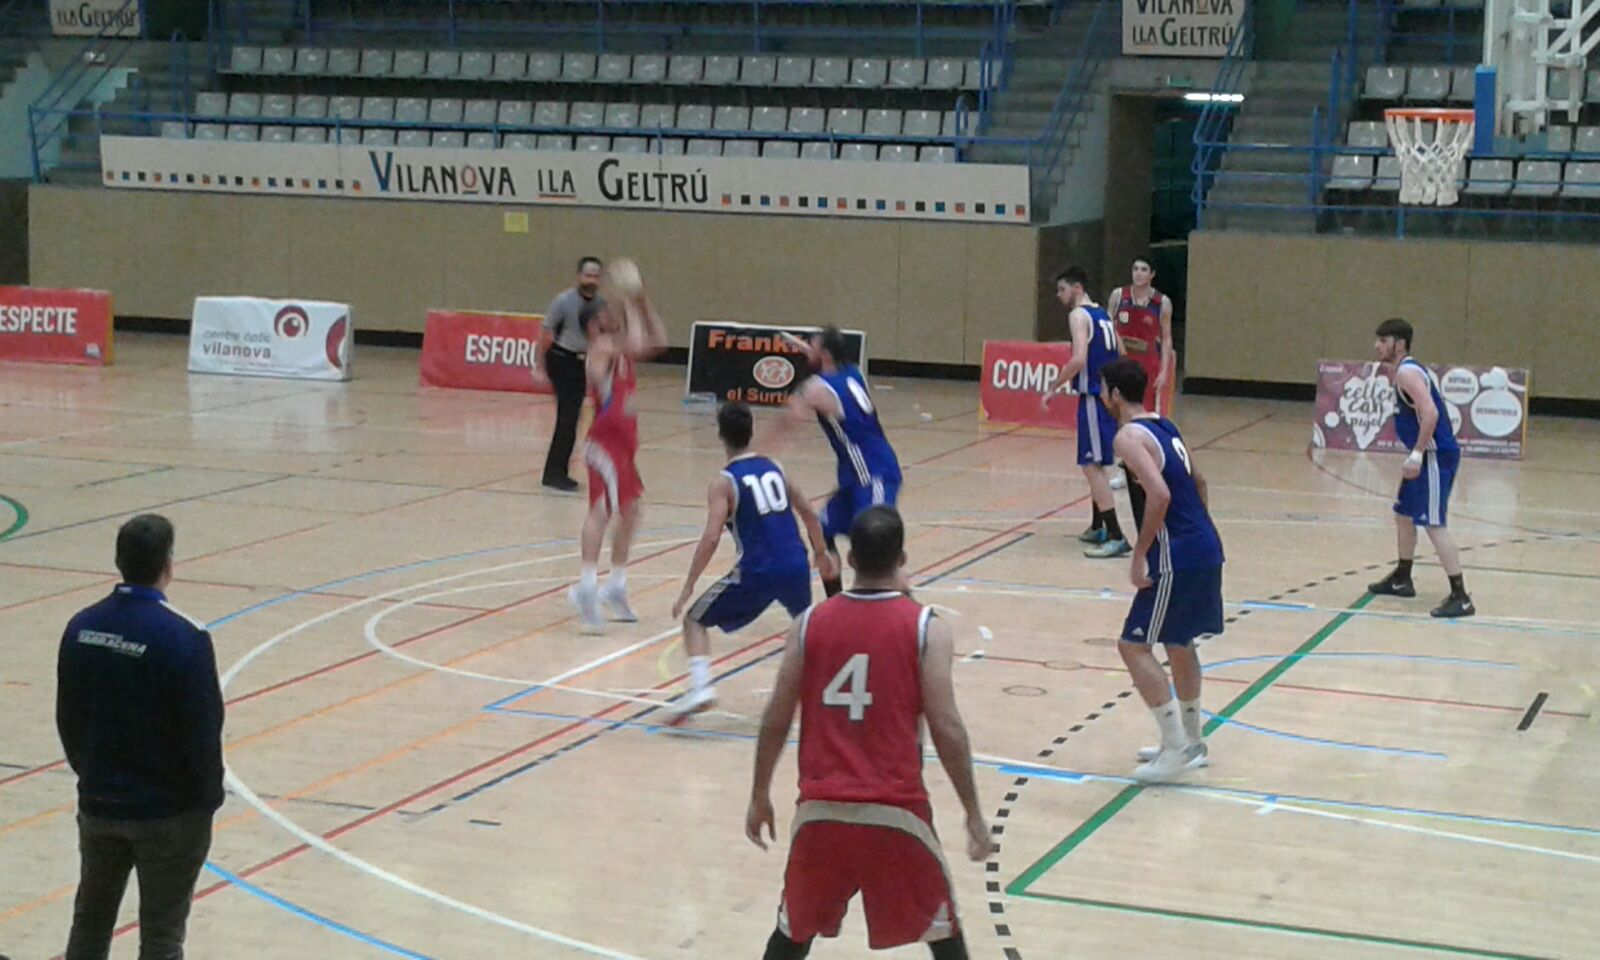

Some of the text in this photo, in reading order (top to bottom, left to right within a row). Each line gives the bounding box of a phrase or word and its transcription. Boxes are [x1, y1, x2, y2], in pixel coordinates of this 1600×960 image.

[1161, 17, 1234, 47] GELTRÚ
[370, 151, 516, 197] VILANOVA
[598, 158, 708, 203] GELTRÚ
[203, 341, 271, 359] vilanova
[742, 470, 788, 516] 10
[822, 653, 873, 721] 4
